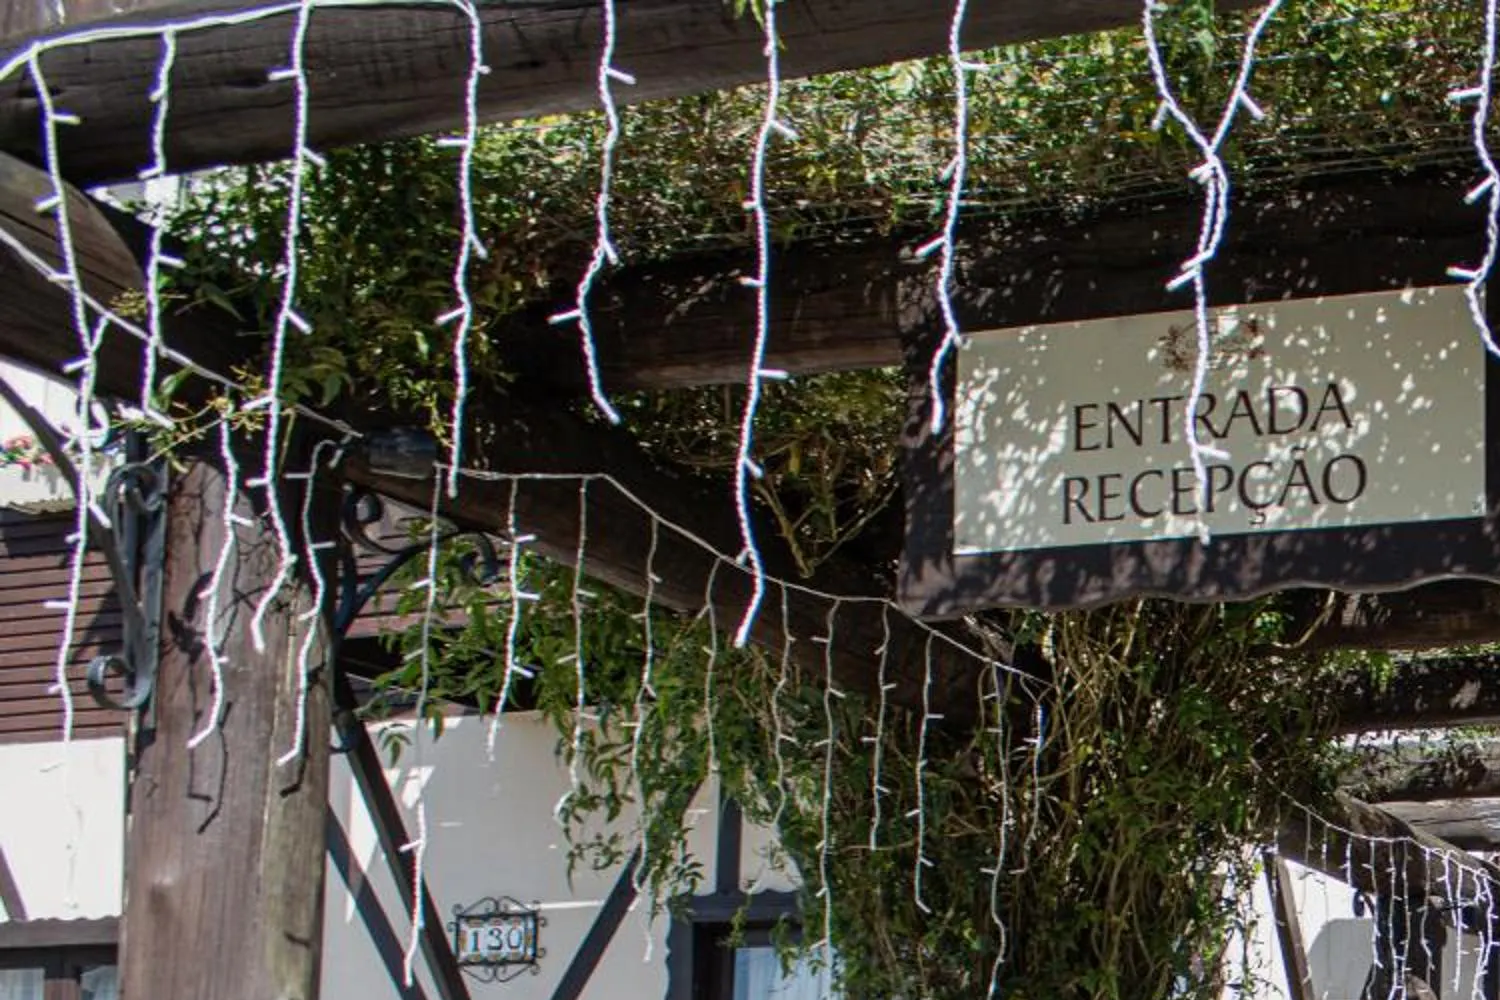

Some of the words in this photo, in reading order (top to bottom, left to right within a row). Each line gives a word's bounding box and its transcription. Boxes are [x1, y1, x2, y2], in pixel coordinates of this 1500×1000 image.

[1073, 382, 1354, 453] ENTRADA
[1062, 446, 1367, 525] RECEPÇÃO
[471, 927, 524, 953] 130
